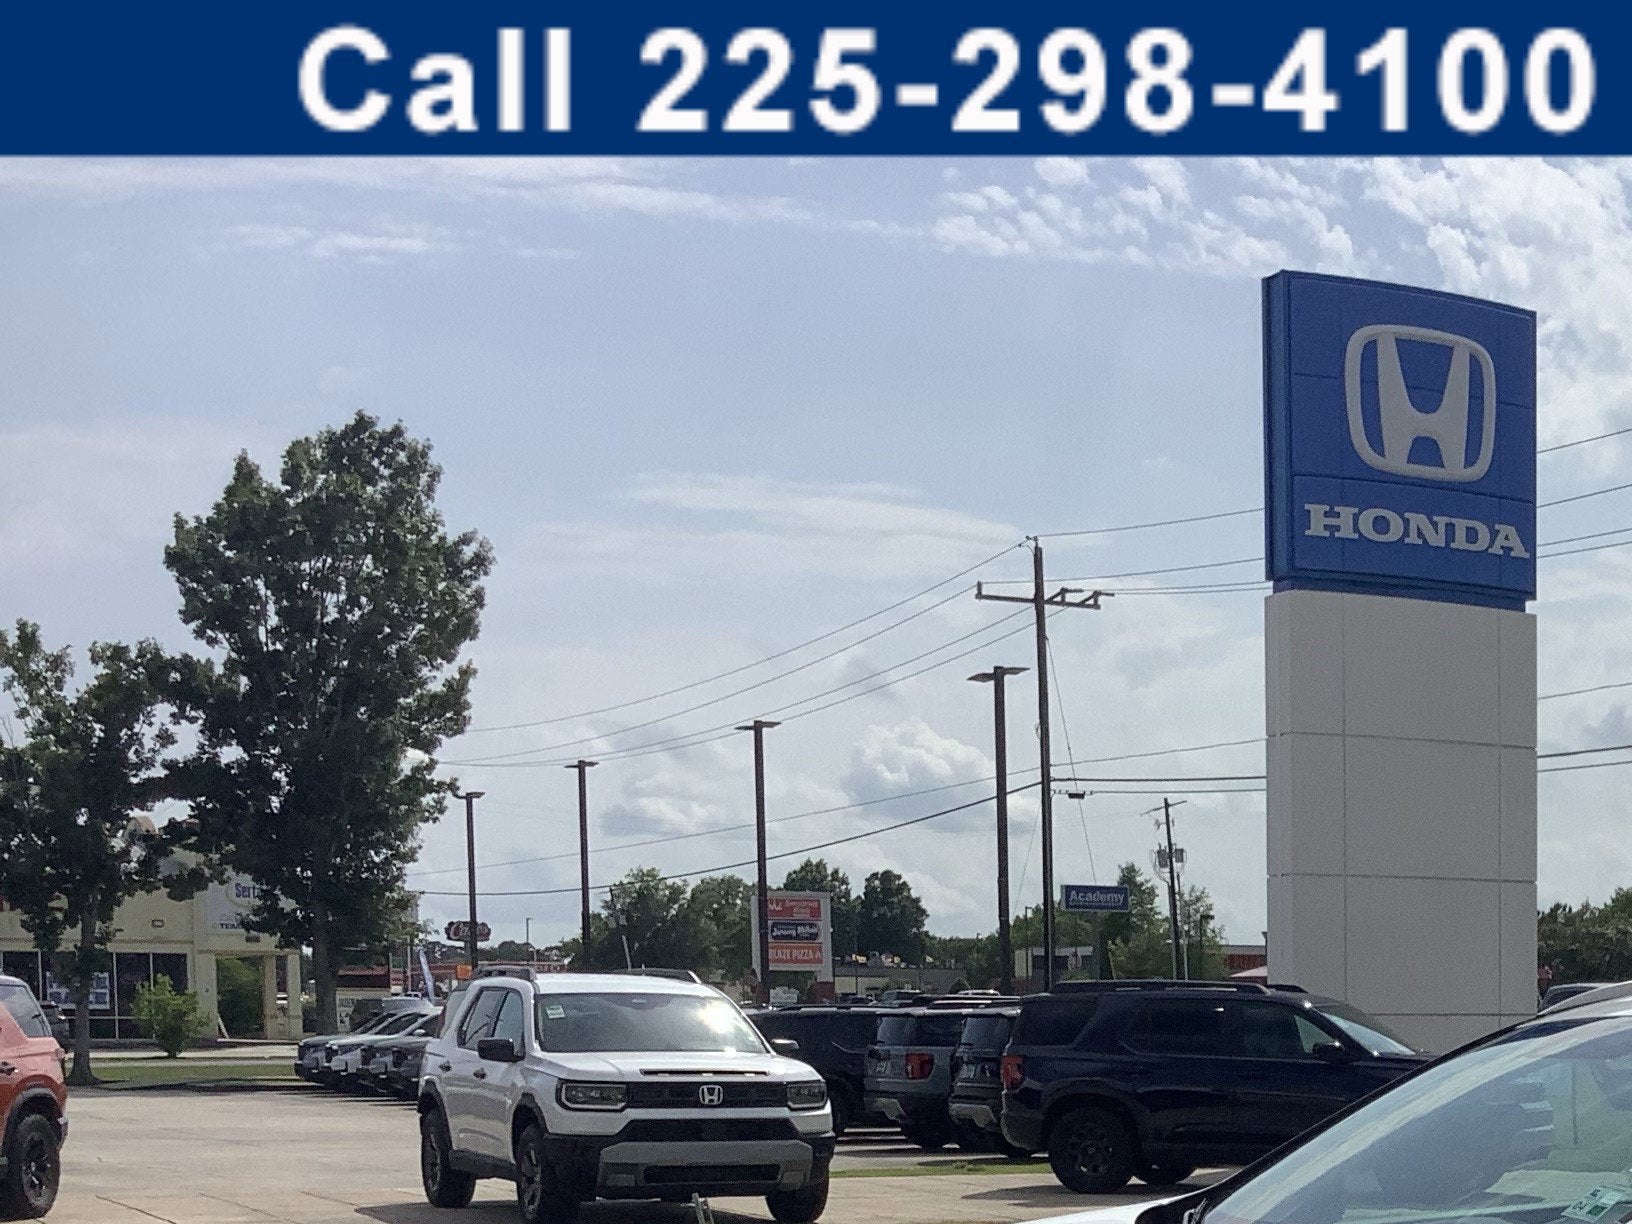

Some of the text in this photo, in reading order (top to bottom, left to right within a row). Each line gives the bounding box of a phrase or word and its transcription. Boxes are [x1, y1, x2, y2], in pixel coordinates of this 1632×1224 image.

[1303, 502, 1531, 559] HONDA
[1069, 890, 1125, 905] Academy
[791, 948, 814, 960] PIZZA
